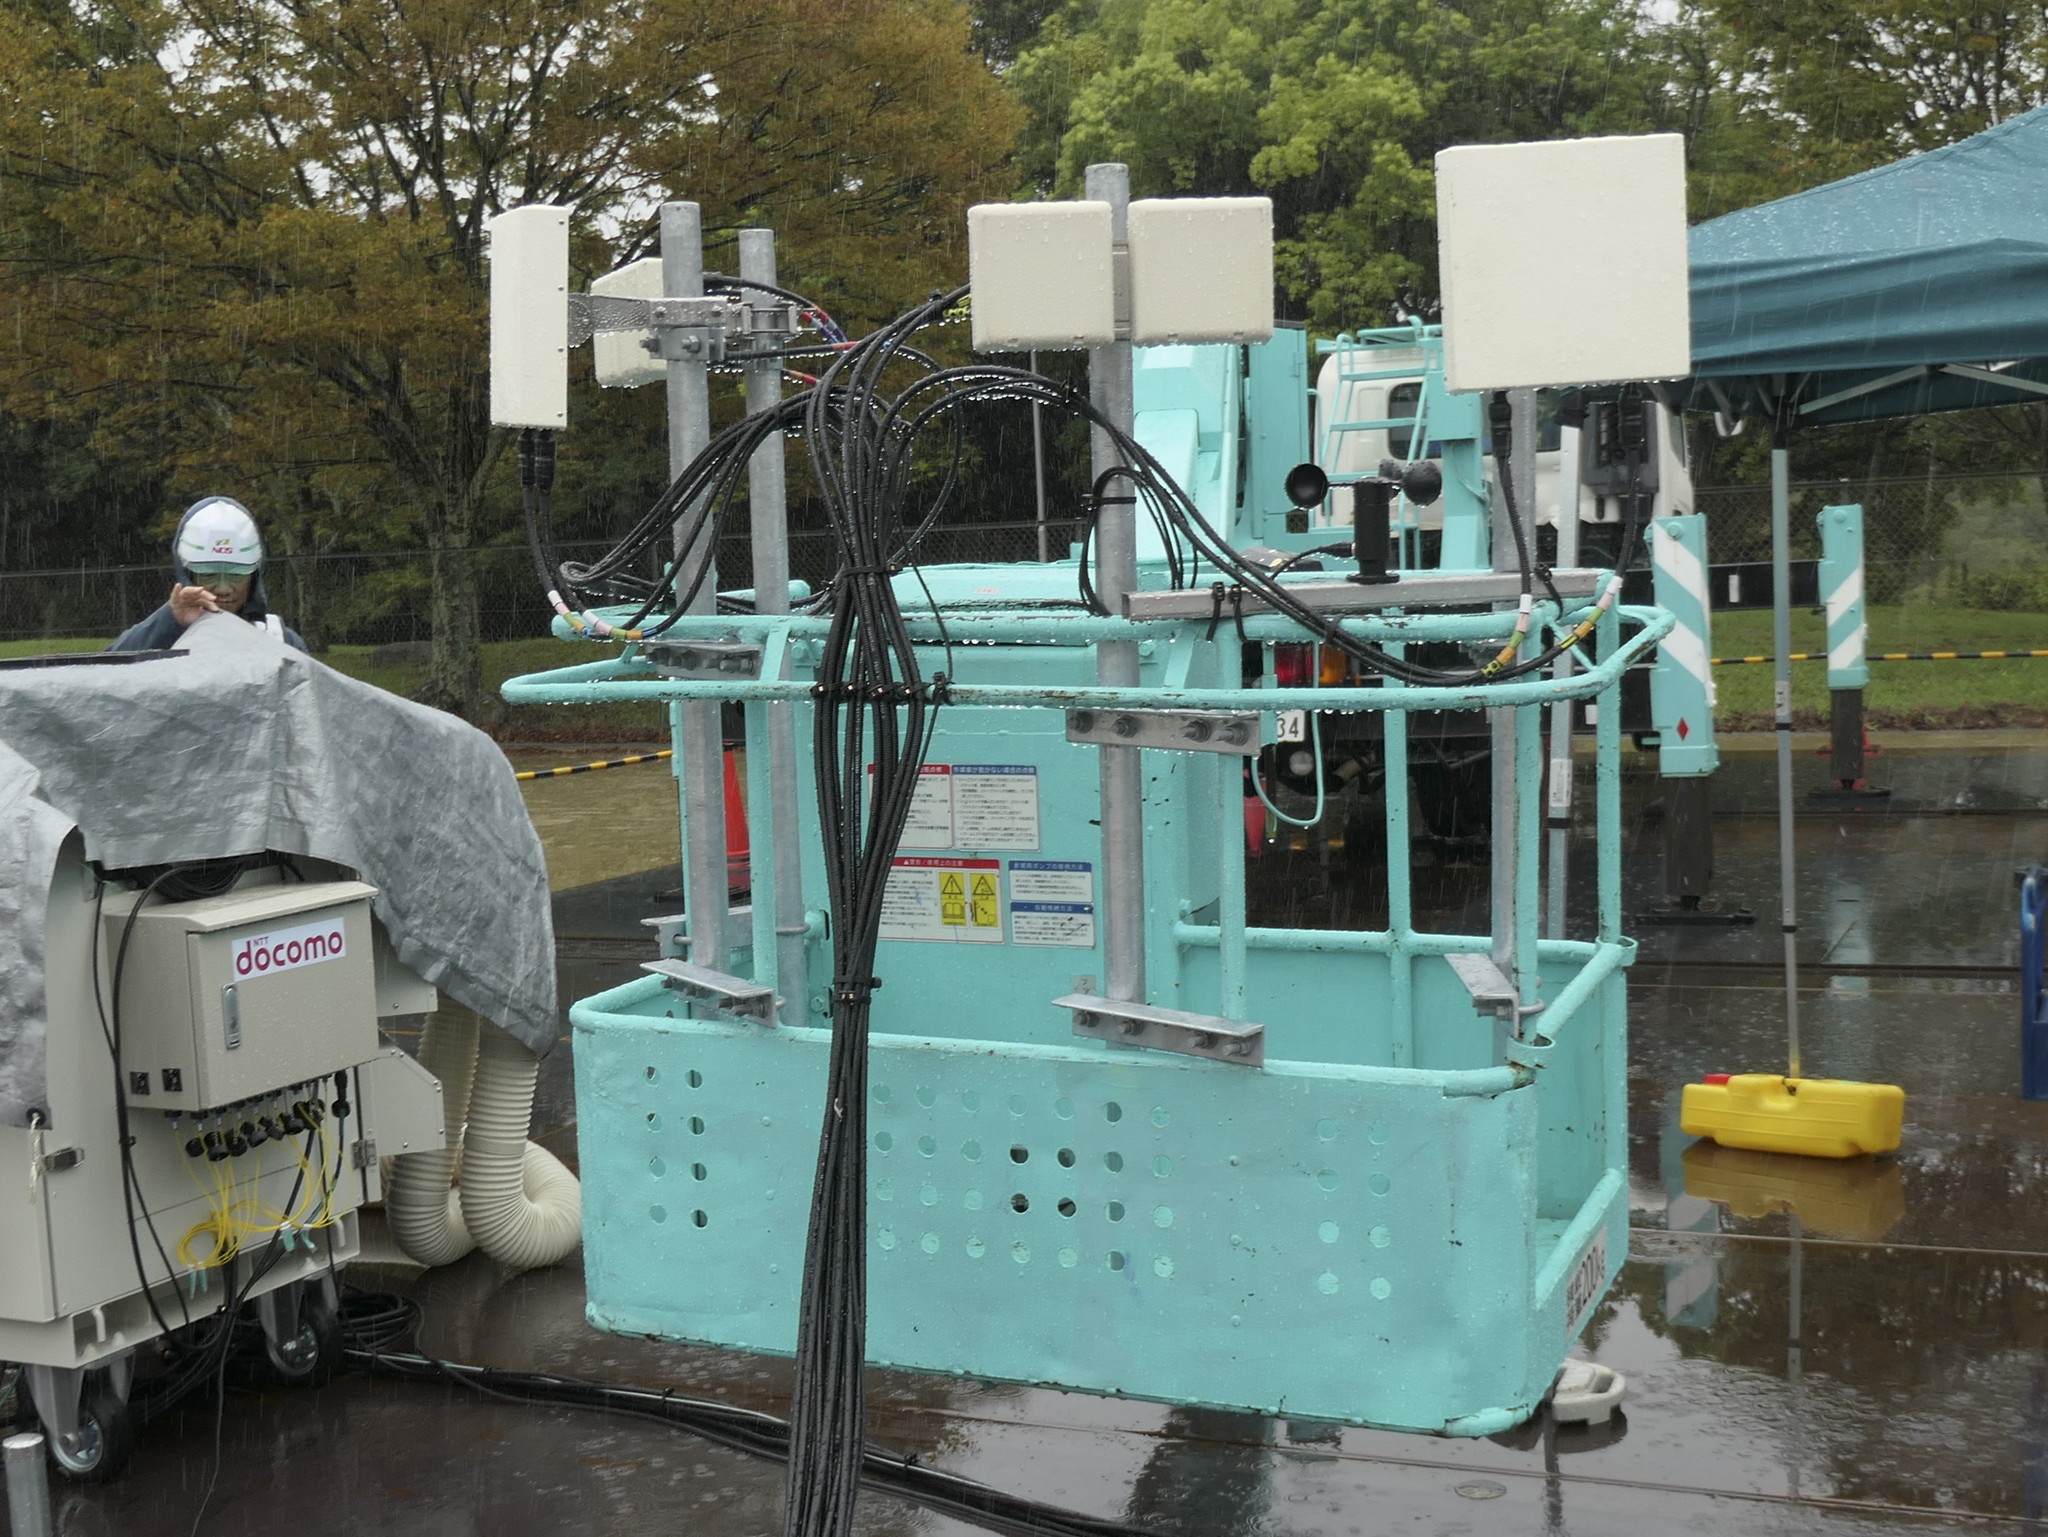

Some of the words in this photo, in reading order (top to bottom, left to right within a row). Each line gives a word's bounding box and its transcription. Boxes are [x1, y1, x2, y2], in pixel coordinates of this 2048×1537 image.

[1277, 717, 1299, 738] 34
[253, 936, 270, 947] NTT
[236, 931, 343, 975] docomo
